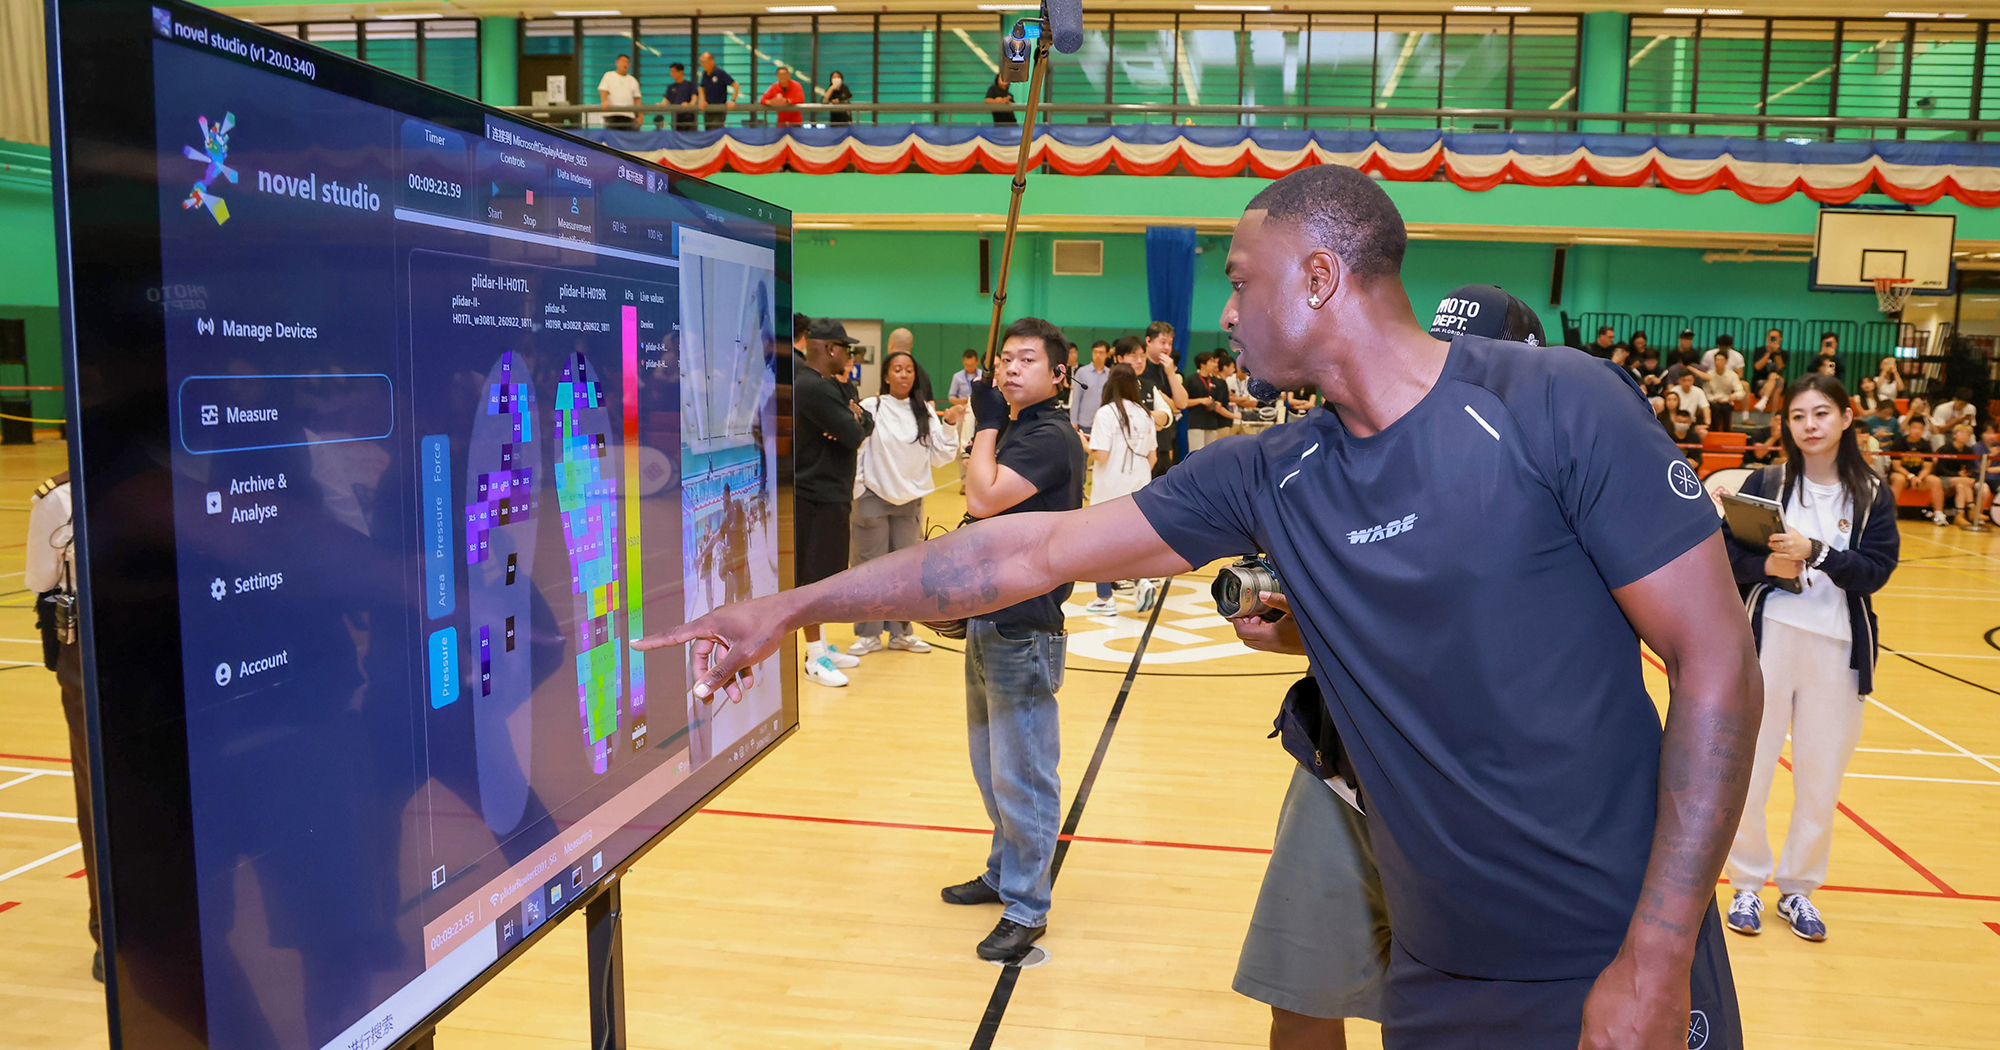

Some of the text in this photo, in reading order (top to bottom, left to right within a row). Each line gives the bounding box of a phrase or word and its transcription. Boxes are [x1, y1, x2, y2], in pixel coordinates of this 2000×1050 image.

[174, 22, 316, 80] novel studio (v1.20.0.340)
[424, 128, 446, 146] Timer
[500, 152, 526, 168] Controls
[408, 173, 462, 199] 00:09:23.59
[570, 172, 592, 189] Indexing
[258, 170, 380, 212] novel studio
[487, 206, 503, 220] Start
[523, 214, 537, 229] Stop
[557, 217, 592, 234] Measurement
[612, 220, 628, 234] 60 Hz
[471, 273, 530, 293] plidar-II-H017L
[452, 295, 481, 308] plidar-II-
[559, 284, 607, 301] plidar-II-H019R
[624, 289, 634, 301] kPa
[640, 291, 665, 304] Live values
[545, 303, 568, 315] plidar-II-
[222, 320, 317, 342] Manage Devices
[640, 320, 654, 330] Device
[1432, 314, 1468, 331] DEPT.
[226, 407, 279, 424] Measure
[433, 442, 442, 482] Force
[229, 473, 288, 495] Archive &
[231, 503, 278, 524] Analyse
[436, 497, 444, 558] Pressure
[1346, 513, 1418, 544] WADE
[234, 571, 284, 595] Settings
[438, 574, 446, 607] Area
[239, 650, 289, 678] Account
[442, 637, 450, 697] Pressure
[633, 694, 644, 707] 40.0
[635, 738, 645, 750] 20.0
[563, 829, 593, 855] Measuring
[430, 911, 475, 951] 00:09:23.59
